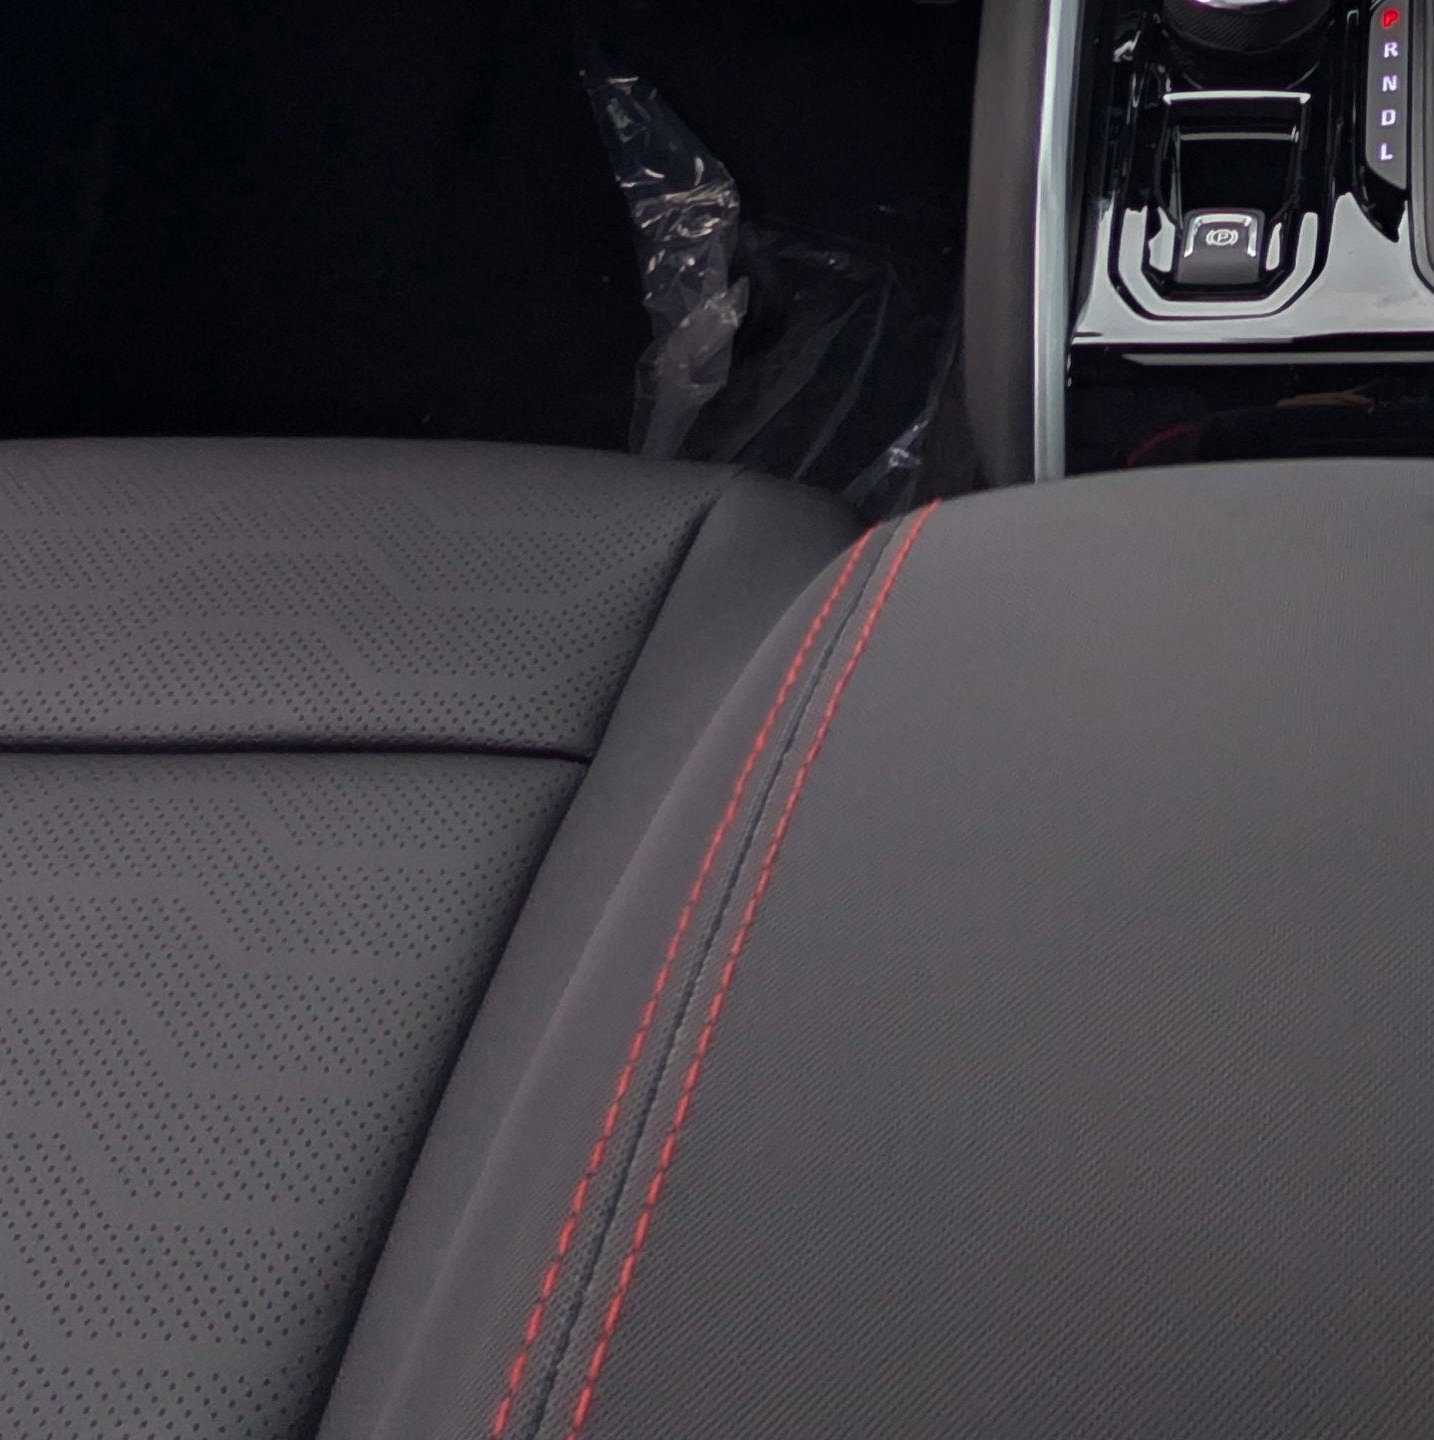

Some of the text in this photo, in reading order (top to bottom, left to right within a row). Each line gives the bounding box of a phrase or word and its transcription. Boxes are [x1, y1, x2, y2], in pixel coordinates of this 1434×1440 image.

[1382, 10, 1399, 28] P
[1384, 41, 1399, 58] R
[1382, 75, 1398, 92] N
[1380, 109, 1397, 126] D
[1380, 143, 1394, 161] L
